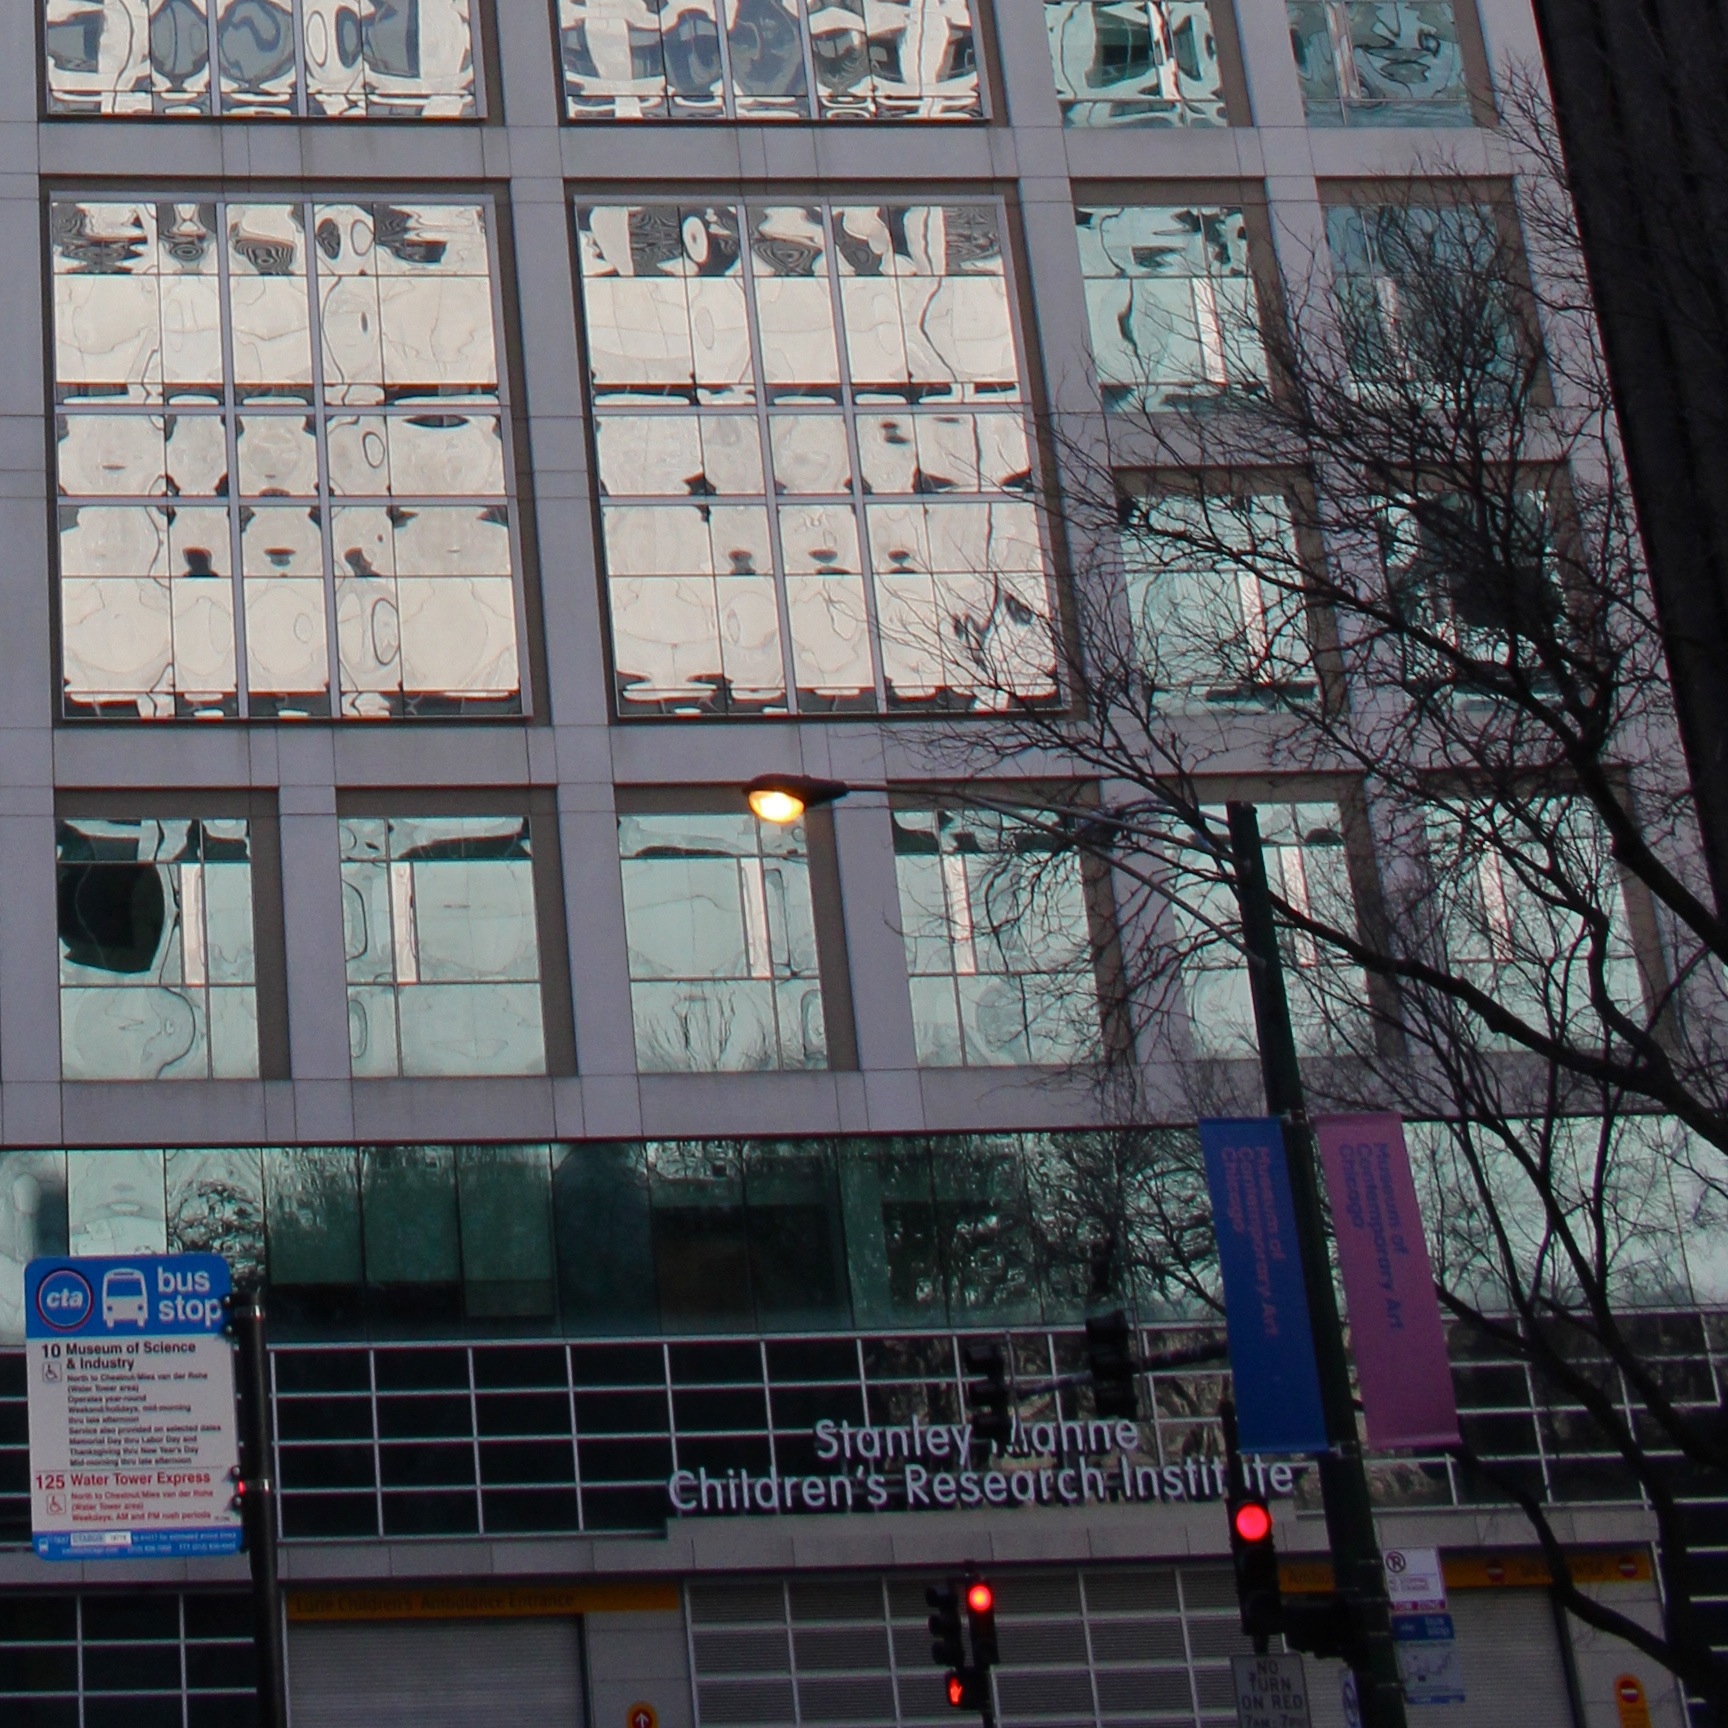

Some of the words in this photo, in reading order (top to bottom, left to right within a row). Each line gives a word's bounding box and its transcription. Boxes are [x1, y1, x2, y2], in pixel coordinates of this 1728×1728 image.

[1339, 1145, 1363, 1228] Chicago
[157, 1266, 210, 1294] bus
[46, 1288, 84, 1309] cta
[158, 1294, 222, 1329] stop
[1386, 1299, 1404, 1330] Art
[42, 1344, 61, 1358] 10
[66, 1343, 122, 1355] Museum
[126, 1342, 139, 1354] of
[144, 1341, 196, 1354] Science
[66, 1358, 75, 1369] &
[80, 1357, 135, 1371] Industry
[814, 1414, 972, 1467] Stanley
[36, 1474, 66, 1489] 125
[70, 1474, 110, 1487] Water
[114, 1473, 152, 1486] Tower
[157, 1472, 211, 1487] Express
[669, 1464, 887, 1510] Children's
[905, 1455, 1104, 1507] Research
[1257, 1659, 1279, 1675] NO
[1249, 1672, 1291, 1692] TURN
[1242, 1694, 1264, 1710] ON
[1272, 1694, 1303, 1710] RED
